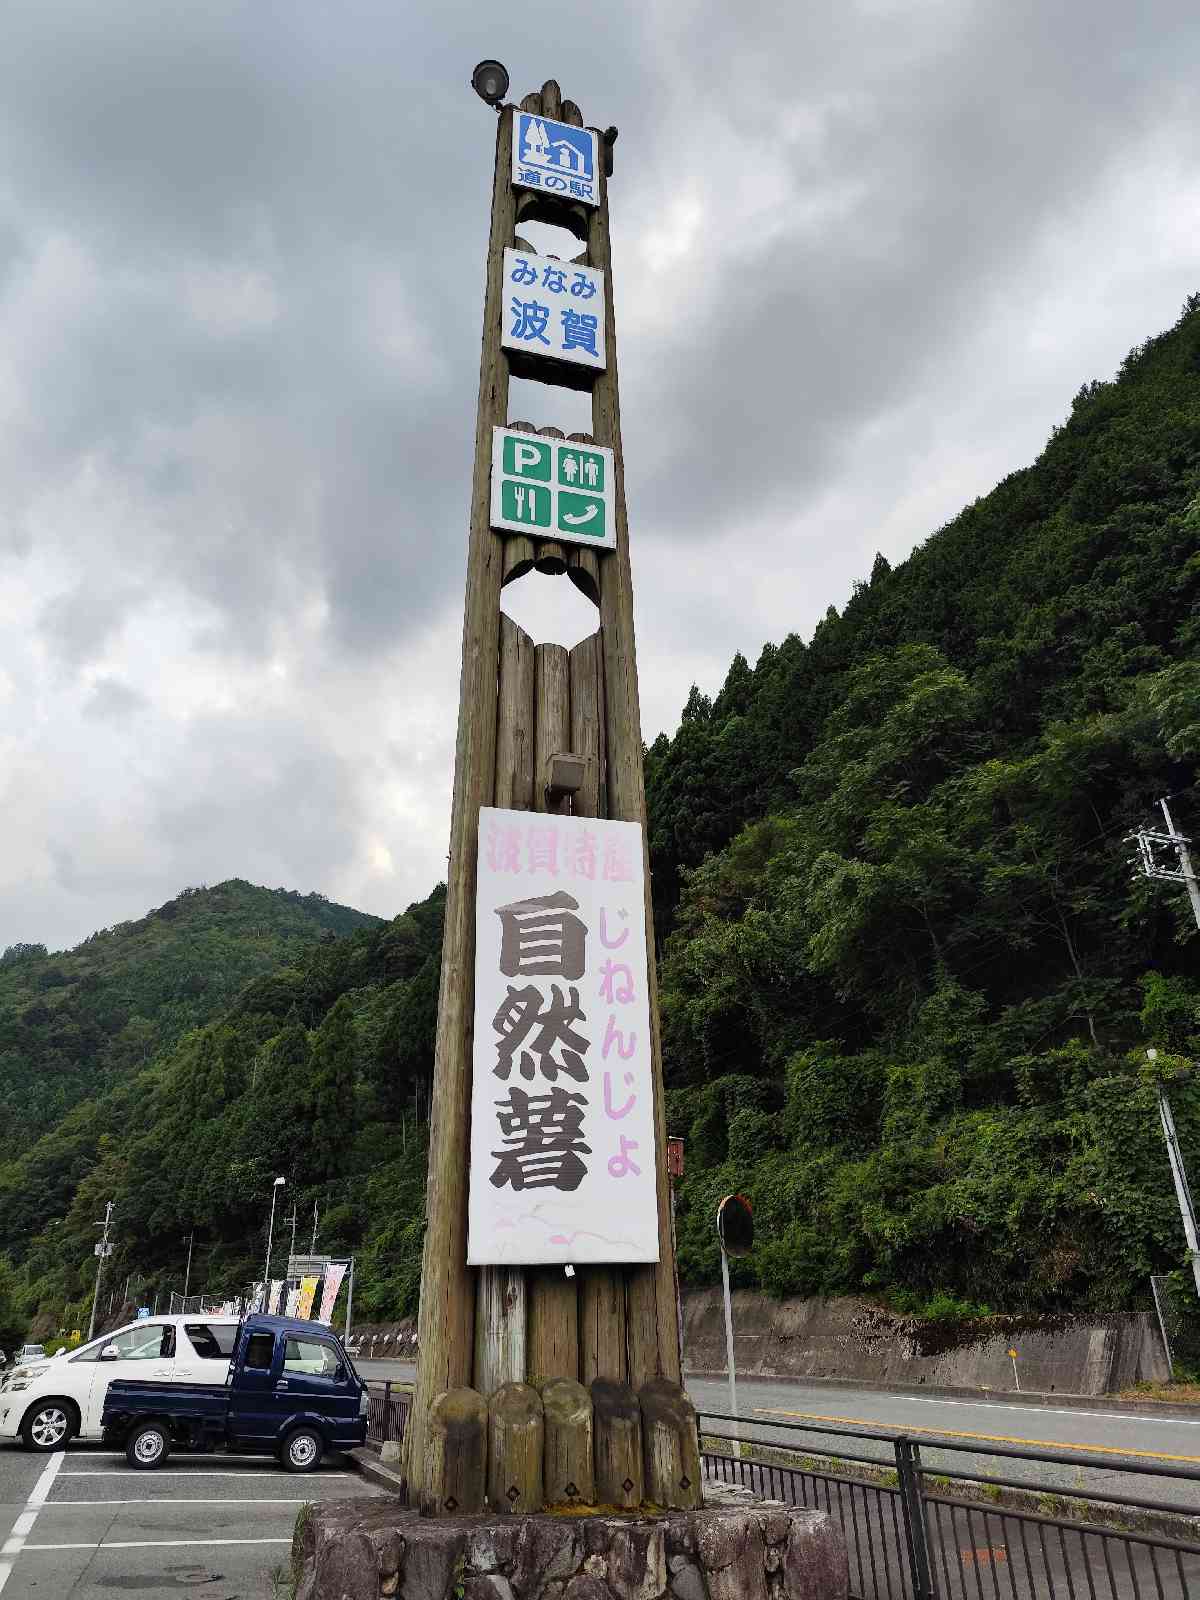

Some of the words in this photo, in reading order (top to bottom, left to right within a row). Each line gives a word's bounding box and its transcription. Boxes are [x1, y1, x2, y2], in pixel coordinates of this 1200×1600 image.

[518, 167, 593, 200] 道の駅
[511, 258, 596, 299] みなみ
[511, 297, 599, 358] 波賀
[514, 442, 542, 474] P
[489, 890, 592, 1191] 自然薯
